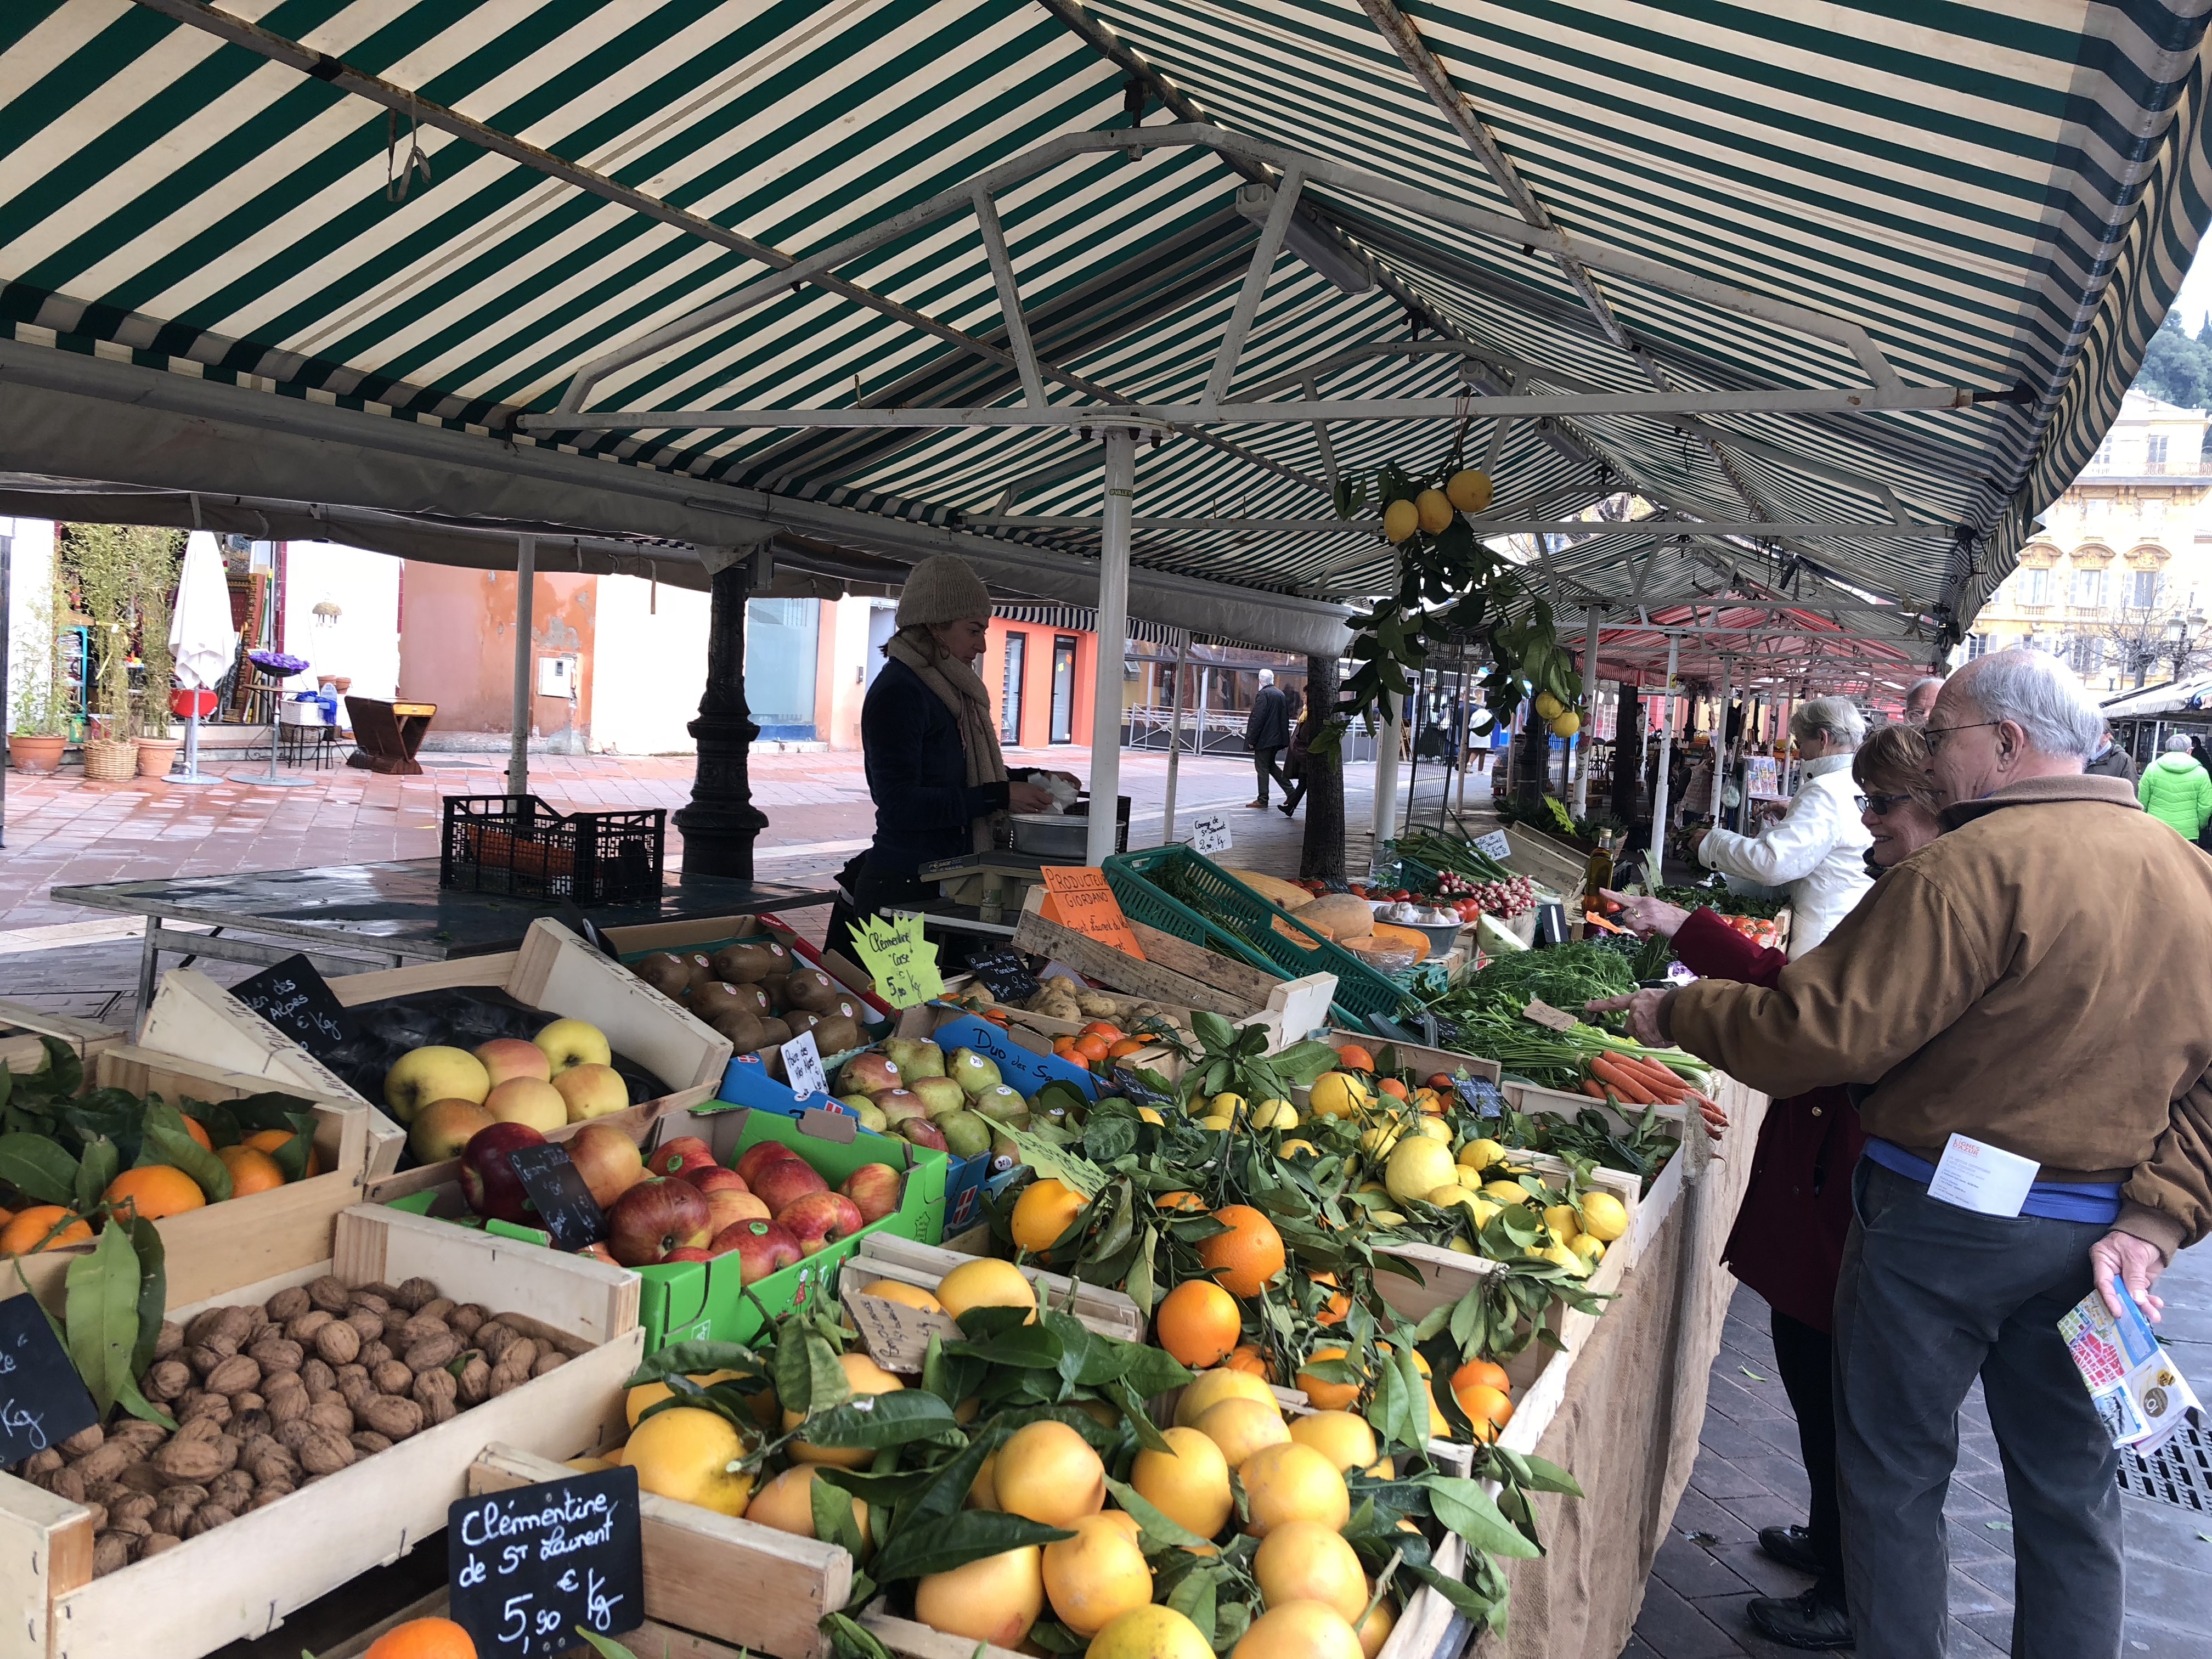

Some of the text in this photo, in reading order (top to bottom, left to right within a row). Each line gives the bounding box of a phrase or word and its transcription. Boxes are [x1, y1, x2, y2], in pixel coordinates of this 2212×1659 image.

[1212, 816, 1218, 824] de
[1045, 868, 1110, 891] PRODUCTEUR
[1065, 891, 1109, 908] GIORDANO
[868, 929, 911, 953] Clémentine
[269, 994, 309, 1021] Alpes
[973, 1028, 1007, 1060] Duo
[461, 1487, 618, 1548] Clémentine
[458, 1553, 487, 1589] de
[539, 1518, 615, 1562] Laurent
[556, 1568, 580, 1593] €
[586, 1567, 624, 1633] Kg
